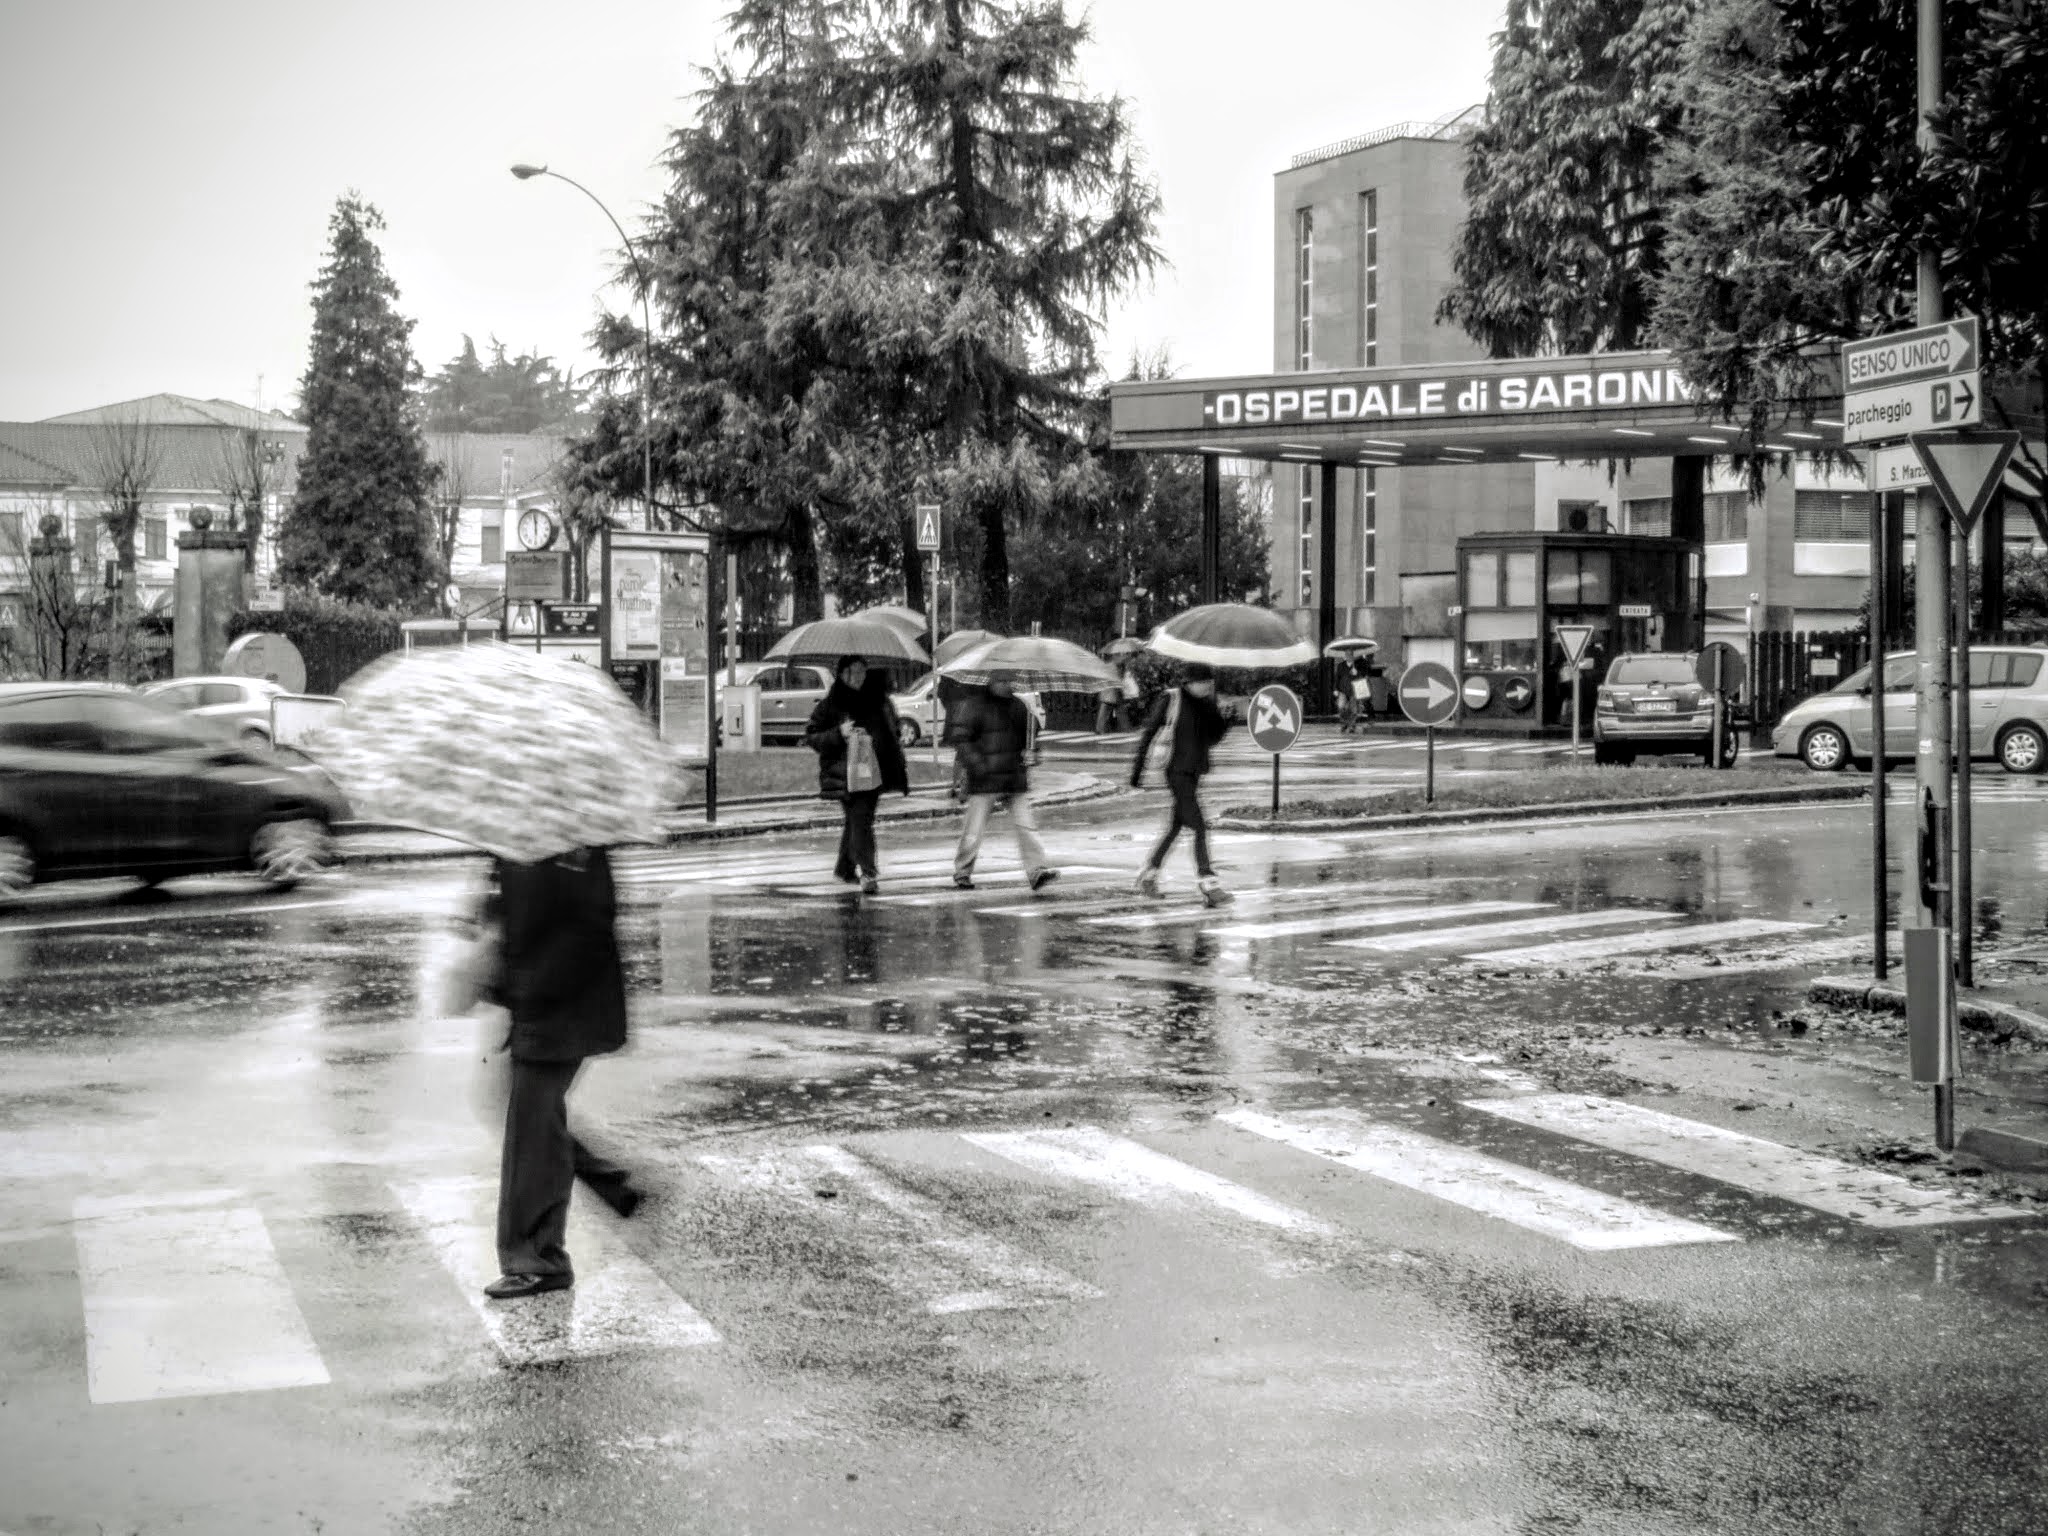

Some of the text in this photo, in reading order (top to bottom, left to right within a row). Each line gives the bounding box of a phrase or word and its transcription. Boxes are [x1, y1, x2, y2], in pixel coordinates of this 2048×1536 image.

[1851, 339, 1951, 379] SENSO UNICO
[1457, 381, 1488, 412] di
[1500, 369, 1722, 410] SARONN
[1848, 399, 1912, 430] parcheggio
